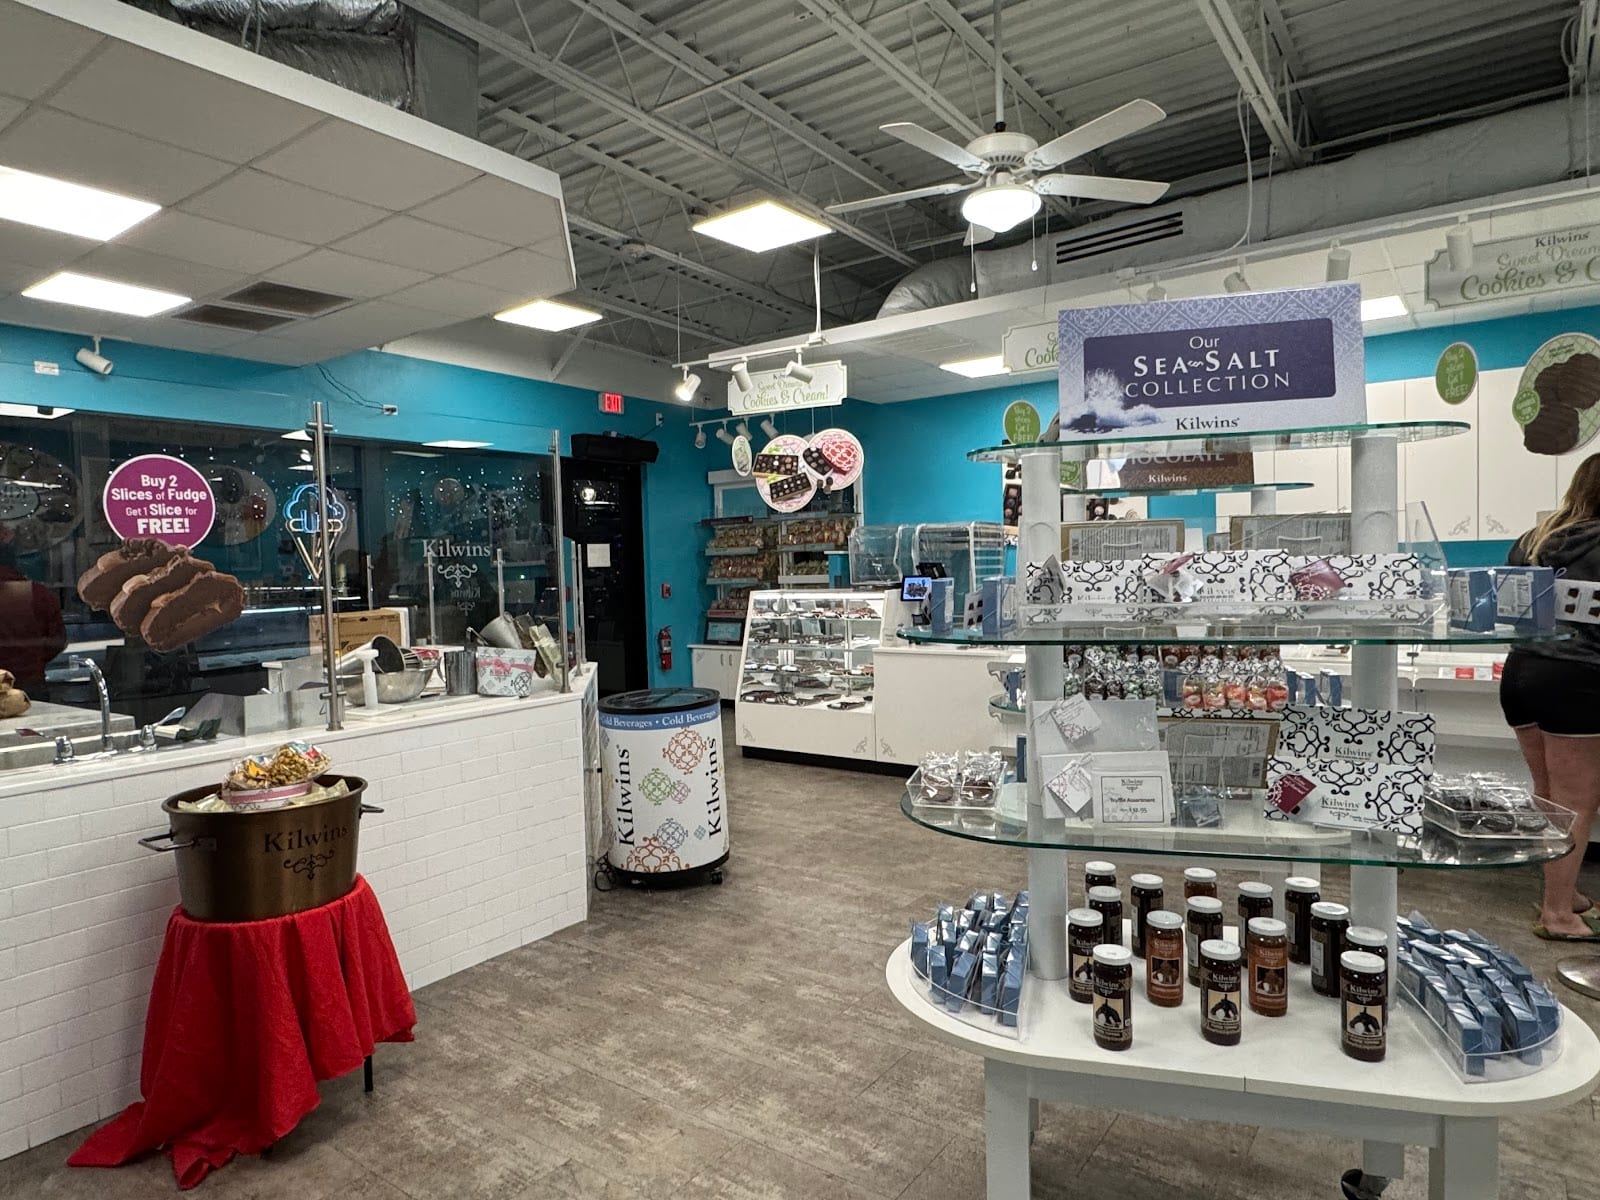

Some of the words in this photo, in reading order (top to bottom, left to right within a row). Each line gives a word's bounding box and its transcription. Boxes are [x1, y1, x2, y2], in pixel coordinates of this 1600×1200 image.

[1535, 231, 1590, 248] Kilwins
[1497, 252, 1540, 270] Sweet
[1460, 267, 1545, 300] Cookies
[1554, 260, 1577, 284] &
[1189, 336, 1220, 349] Our
[1125, 372, 1289, 398] COLLECTION
[604, 393, 621, 413] EXIT
[743, 391, 778, 410] Cookies
[781, 390, 790, 404] &
[793, 384, 829, 405] Cream!
[1176, 416, 1240, 431] Kilwins
[141, 474, 166, 490] Buy
[169, 475, 178, 487] 2
[1148, 474, 1188, 483] Kilwins
[111, 488, 153, 500] Slices
[156, 492, 165, 500] of
[167, 488, 207, 503] Fudge
[126, 507, 142, 516] Get
[143, 507, 148, 515] 1
[149, 504, 182, 516] Slice
[185, 507, 198, 515] for
[137, 518, 190, 534] FREE!
[422, 539, 492, 558] Kilwins
[613, 718, 653, 729] Beverages
[661, 714, 684, 726] Cold
[686, 710, 717, 723] Beverages
[1335, 746, 1373, 758] Kilwins
[705, 738, 722, 839] Kilwins
[615, 748, 635, 846] Kilwins
[1321, 796, 1360, 809] Kilwins
[265, 824, 349, 853] Kilwins
